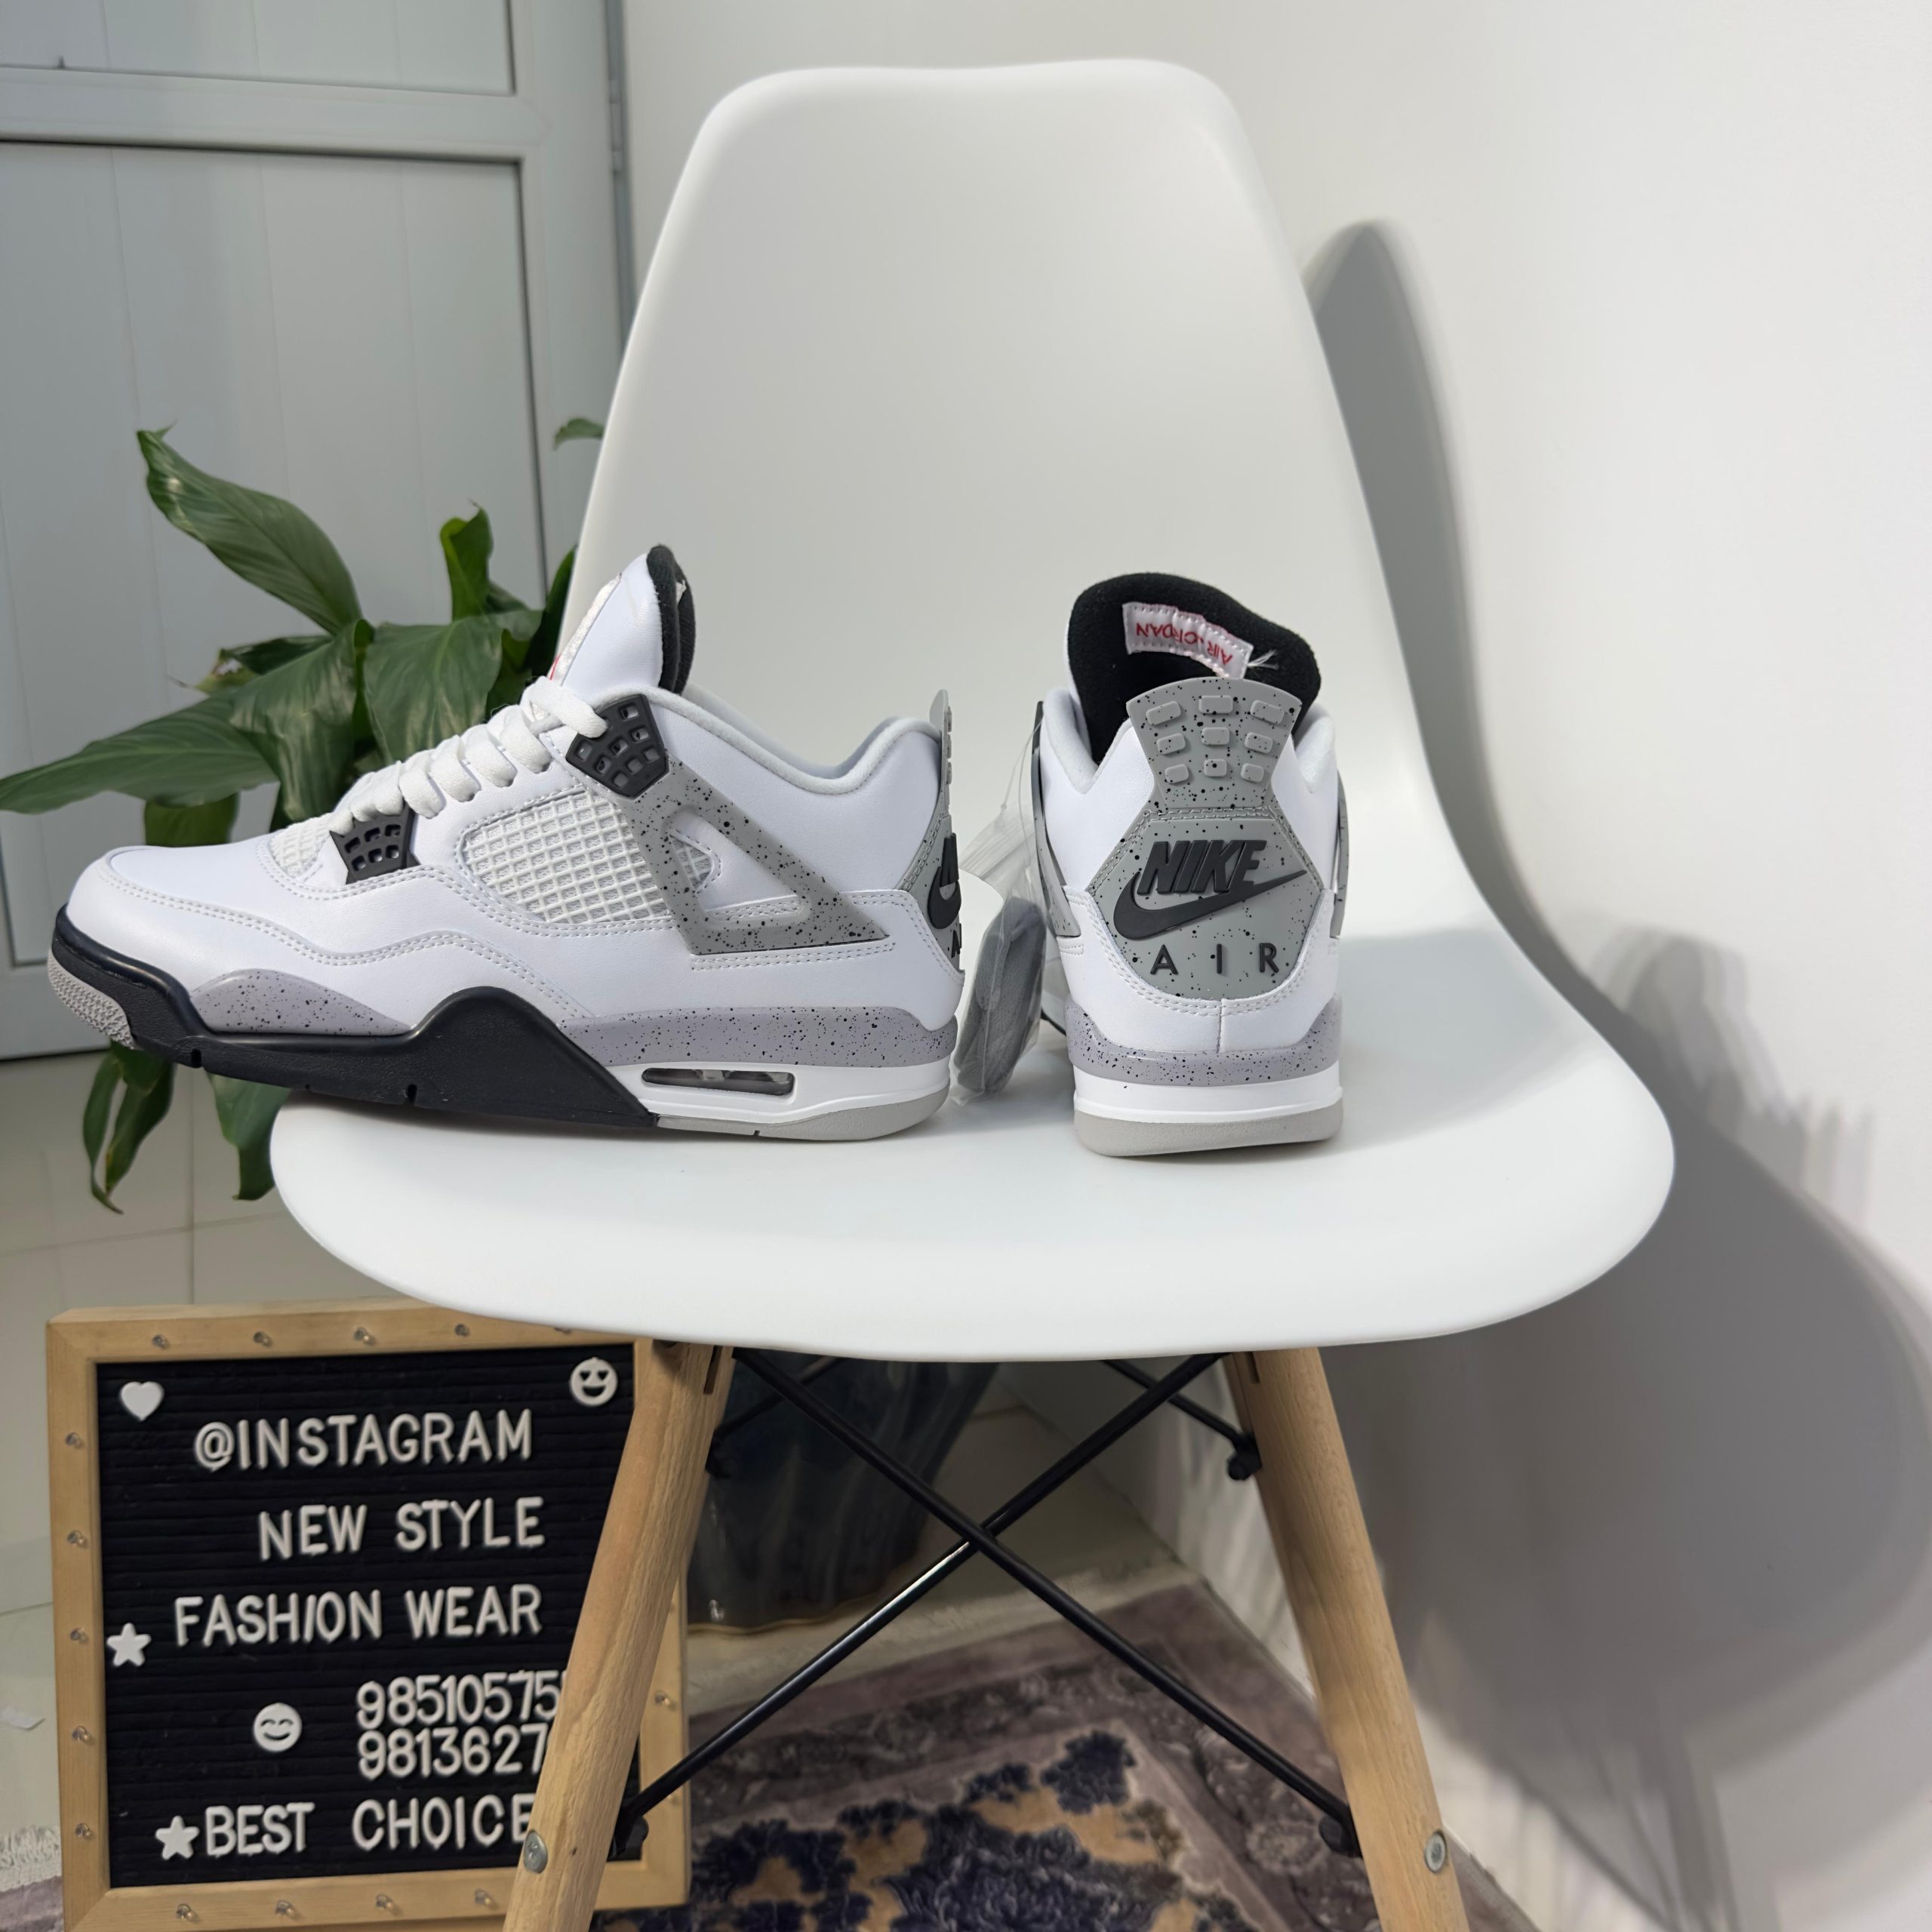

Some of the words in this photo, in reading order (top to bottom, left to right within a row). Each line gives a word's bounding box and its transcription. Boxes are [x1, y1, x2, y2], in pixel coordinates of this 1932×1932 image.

[1208, 640, 1232, 665] AIR
[1136, 839, 1267, 894] NIKE
[1149, 943, 1280, 975] AIR
[194, 1408, 531, 1471] @INSTAGRAM
[259, 1504, 367, 1560] NEW
[396, 1497, 545, 1551] STYLE
[174, 1589, 382, 1647] FASHION
[405, 1584, 541, 1638] WEAR
[356, 1669, 568, 1730] 98510575
[205, 1802, 315, 1858] BEST
[352, 1792, 537, 1850] CHOICE
